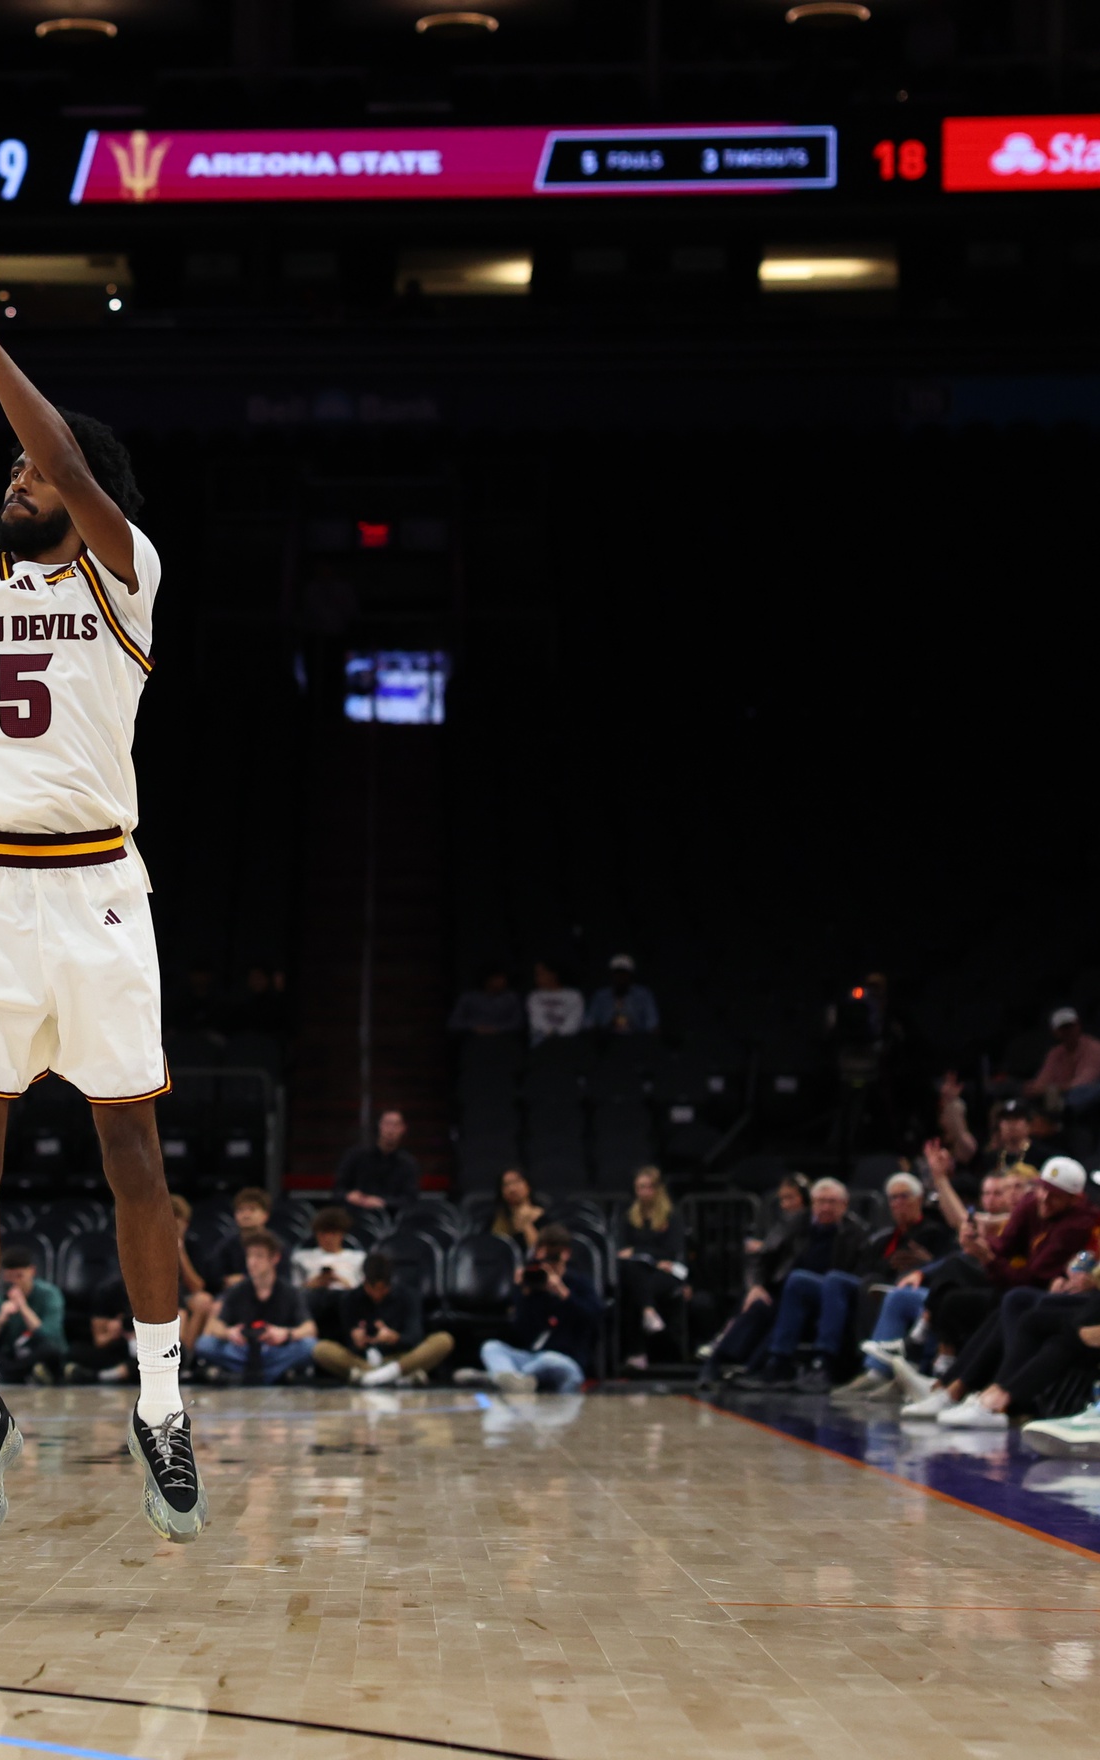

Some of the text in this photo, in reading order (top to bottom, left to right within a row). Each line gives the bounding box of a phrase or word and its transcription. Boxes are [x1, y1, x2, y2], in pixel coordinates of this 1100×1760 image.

[187, 150, 443, 178] ARIZONA STATE
[873, 139, 927, 181] 18
[11, 613, 98, 641] DEVILS
